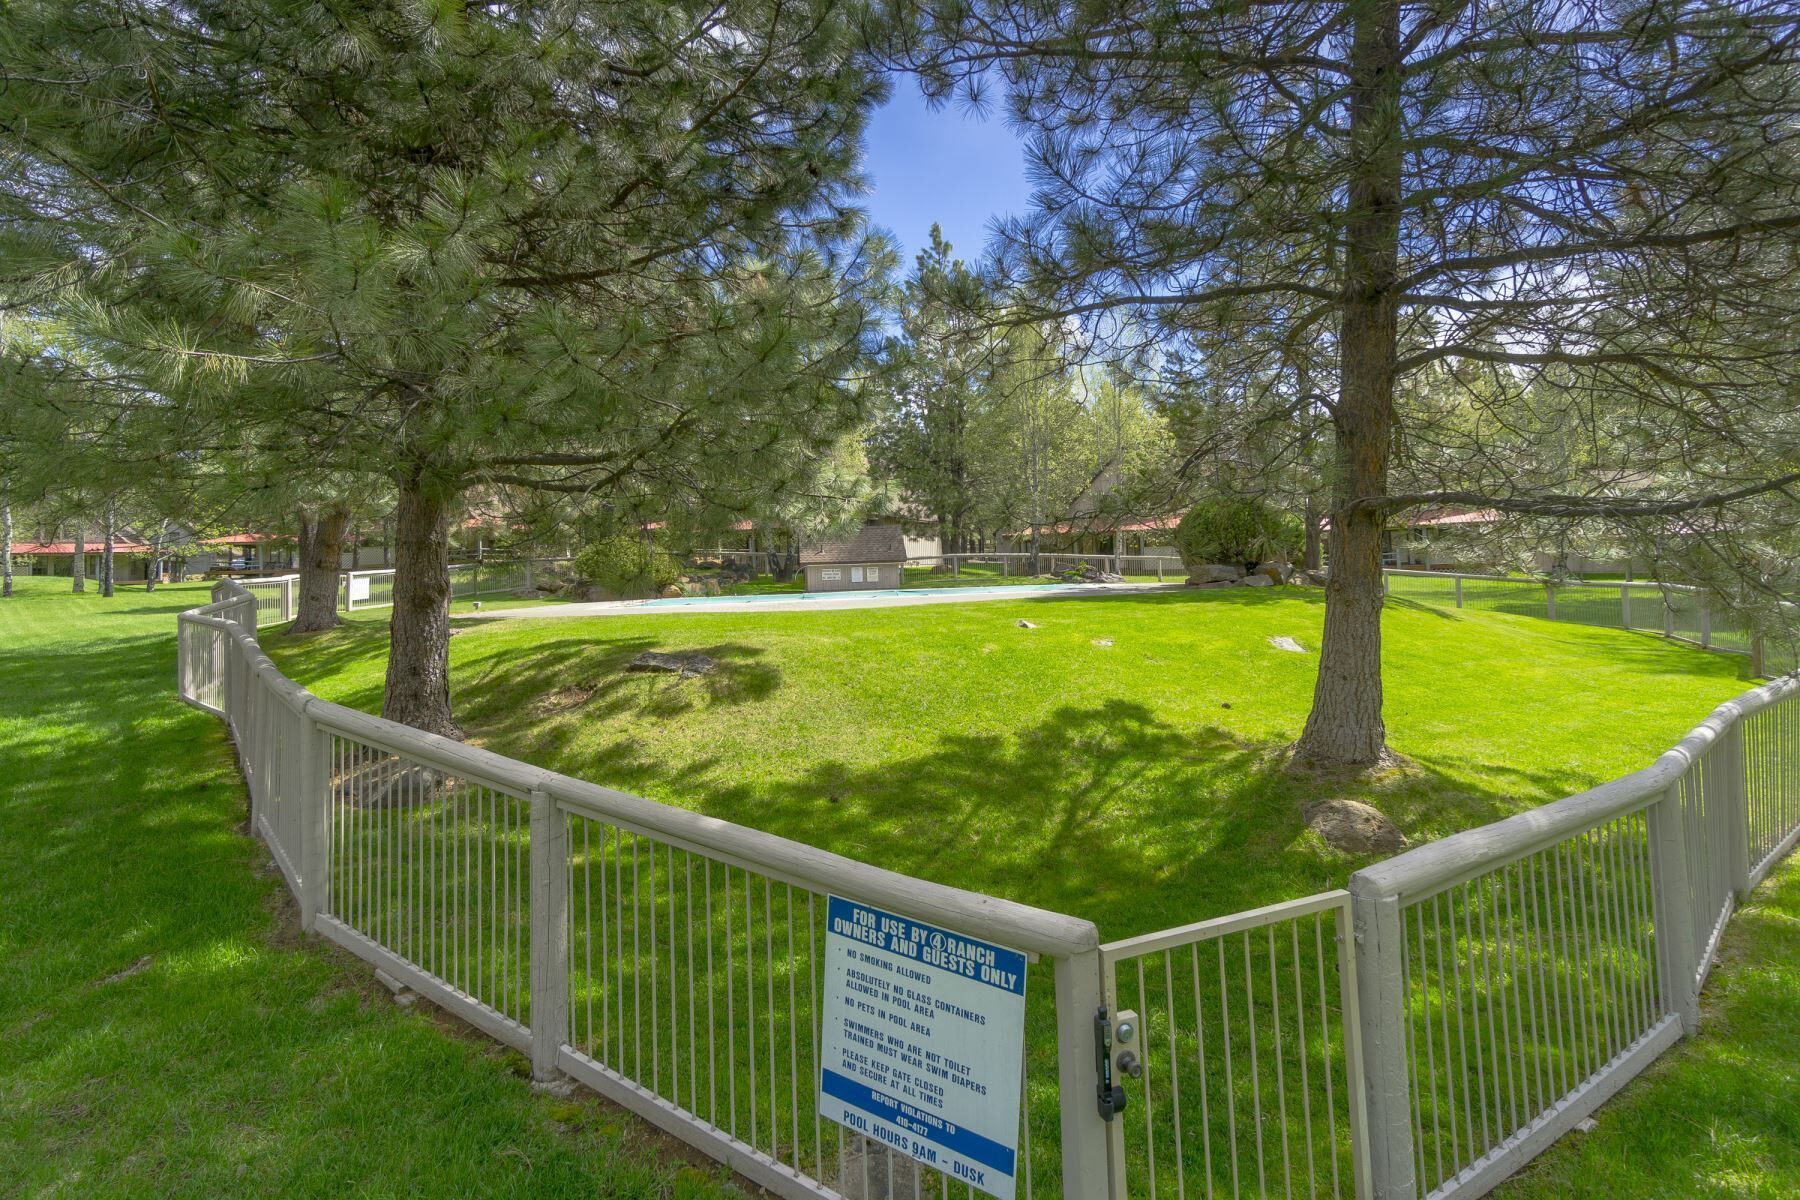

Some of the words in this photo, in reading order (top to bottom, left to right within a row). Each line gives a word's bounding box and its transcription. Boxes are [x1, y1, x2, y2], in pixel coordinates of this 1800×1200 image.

[834, 917, 886, 947] OWNERS
[890, 936, 918, 958] AND
[922, 946, 975, 977] GUESTS
[980, 964, 1017, 990] ONLY
[853, 908, 876, 929] FOR
[881, 917, 906, 938] USE
[911, 926, 928, 945] BY
[947, 937, 996, 968] RANCH
[847, 948, 857, 959] NO
[859, 952, 893, 972] SMOKING
[896, 965, 931, 985] ALLOWED
[844, 996, 855, 1008] NO
[857, 1001, 875, 1016] PETS
[878, 1009, 886, 1020] IN
[888, 1013, 908, 1028] POOL
[910, 1021, 931, 1038] AREA
[846, 968, 891, 991] ABSOLUTELY
[893, 984, 904, 996] NO
[906, 989, 932, 1006] GLASS
[935, 999, 986, 1026] CONTAINERS
[846, 979, 879, 998] ALLOWED
[881, 991, 890, 1002] IN
[892, 995, 911, 1011] POOL
[914, 1004, 935, 1020] AREA
[842, 1048, 869, 1066] PLEASE
[871, 1059, 890, 1074] KEEP
[892, 1068, 911, 1084] GATE
[914, 1077, 944, 1097] CLOSED
[843, 1018, 885, 1042] SWIMMERS
[887, 1035, 904, 1050] WHO
[907, 1043, 922, 1057] ARE
[925, 1050, 941, 1064] NOT
[943, 1057, 971, 1077] TOILET
[843, 1029, 874, 1049] TRAINED
[877, 1042, 898, 1059] MUST
[900, 1052, 923, 1069] WEAR
[925, 1063, 949, 1080] SWIM
[951, 1073, 987, 1096] DIAPERS
[842, 1059, 857, 1072] AND
[859, 1066, 887, 1085] SECURE
[890, 1079, 900, 1090] AT
[902, 1084, 916, 1097] ALL
[919, 1090, 943, 1109] TIMES
[871, 1090, 899, 1110] REPORT
[901, 1103, 943, 1129] VIOLATIONS
[945, 1122, 956, 1135] TO
[843, 1110, 869, 1132] POOL
[873, 1123, 908, 1150] HOURS
[912, 1141, 937, 1164] 9AM
[953, 1160, 985, 1187] DUSK
